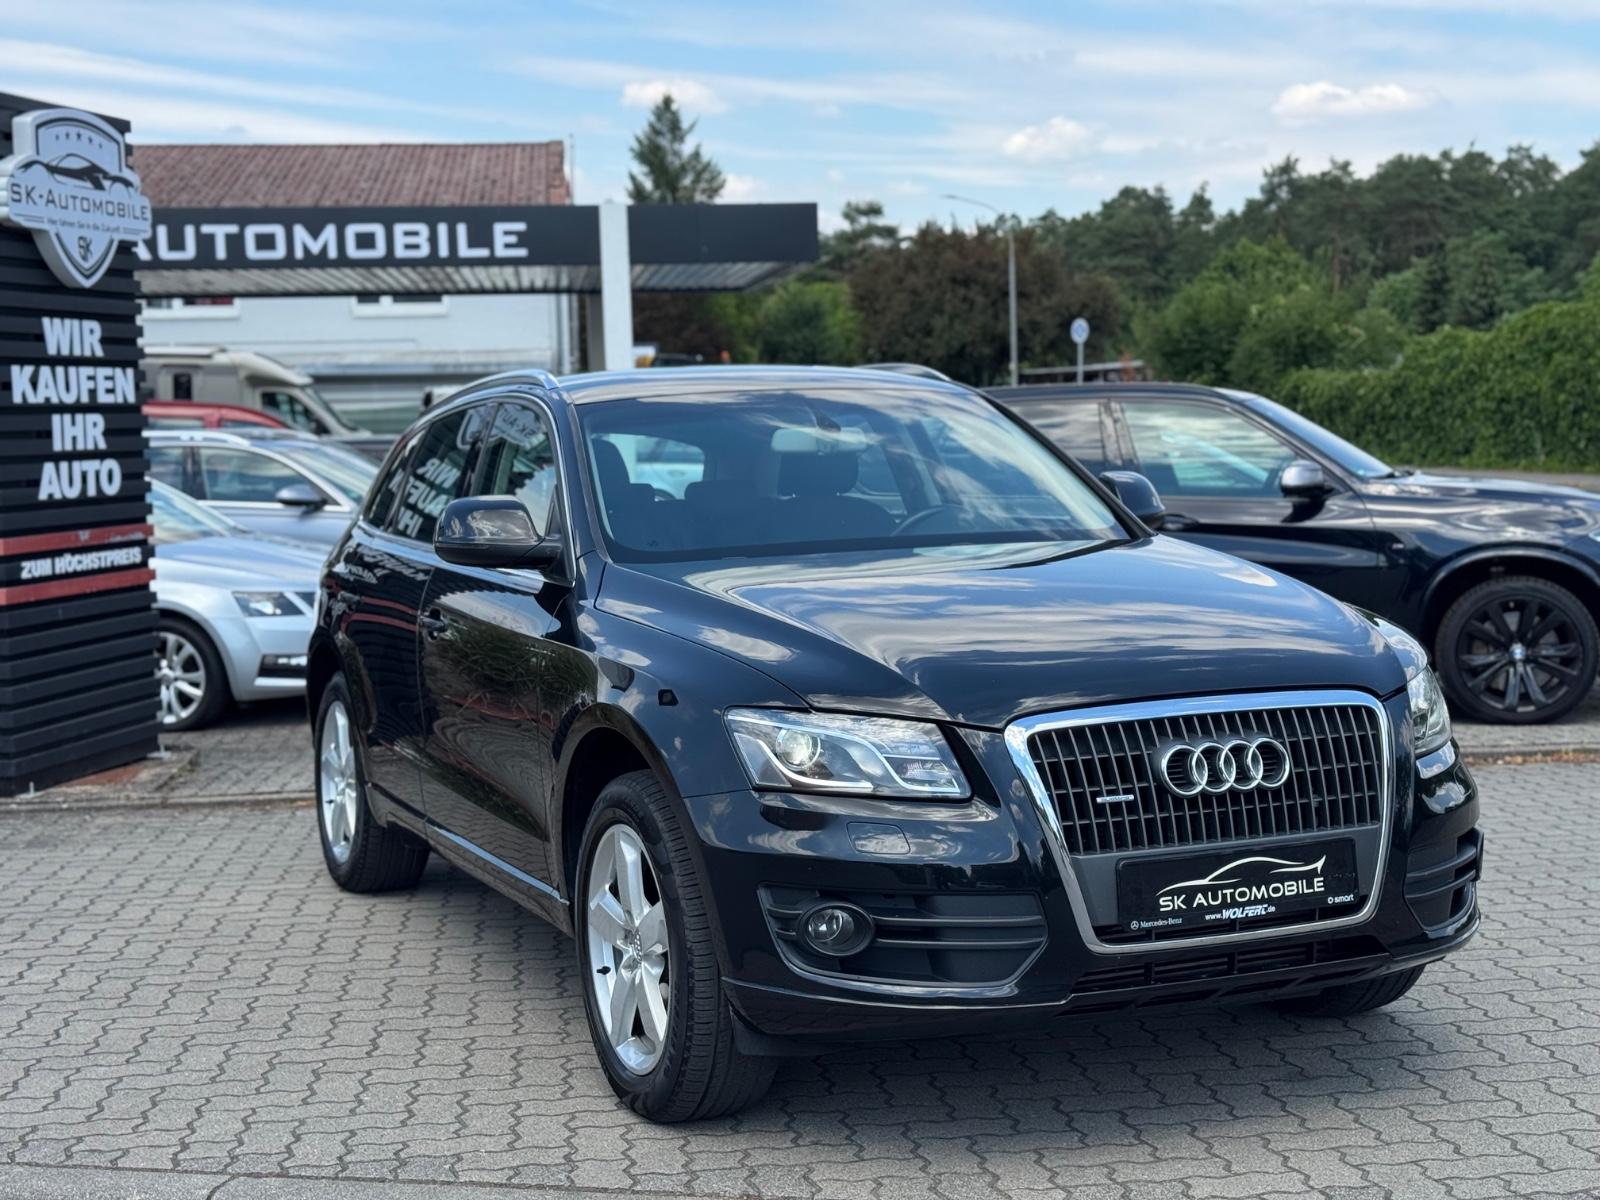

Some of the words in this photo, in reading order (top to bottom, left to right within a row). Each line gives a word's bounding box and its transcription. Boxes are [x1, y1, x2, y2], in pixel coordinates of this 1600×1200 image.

[41, 316, 104, 358] WIR
[10, 364, 136, 404] KAUFEN
[51, 413, 107, 451] IHR
[37, 458, 122, 500] AUTO
[20, 558, 53, 580] ZUM
[54, 546, 143, 575] HÖCHSTPREIS
[1159, 893, 1188, 912] SK
[1192, 876, 1326, 909] AUTOMOBILE
[1334, 893, 1355, 904] smart
[1139, 917, 1183, 929] Mercedes-Benz
